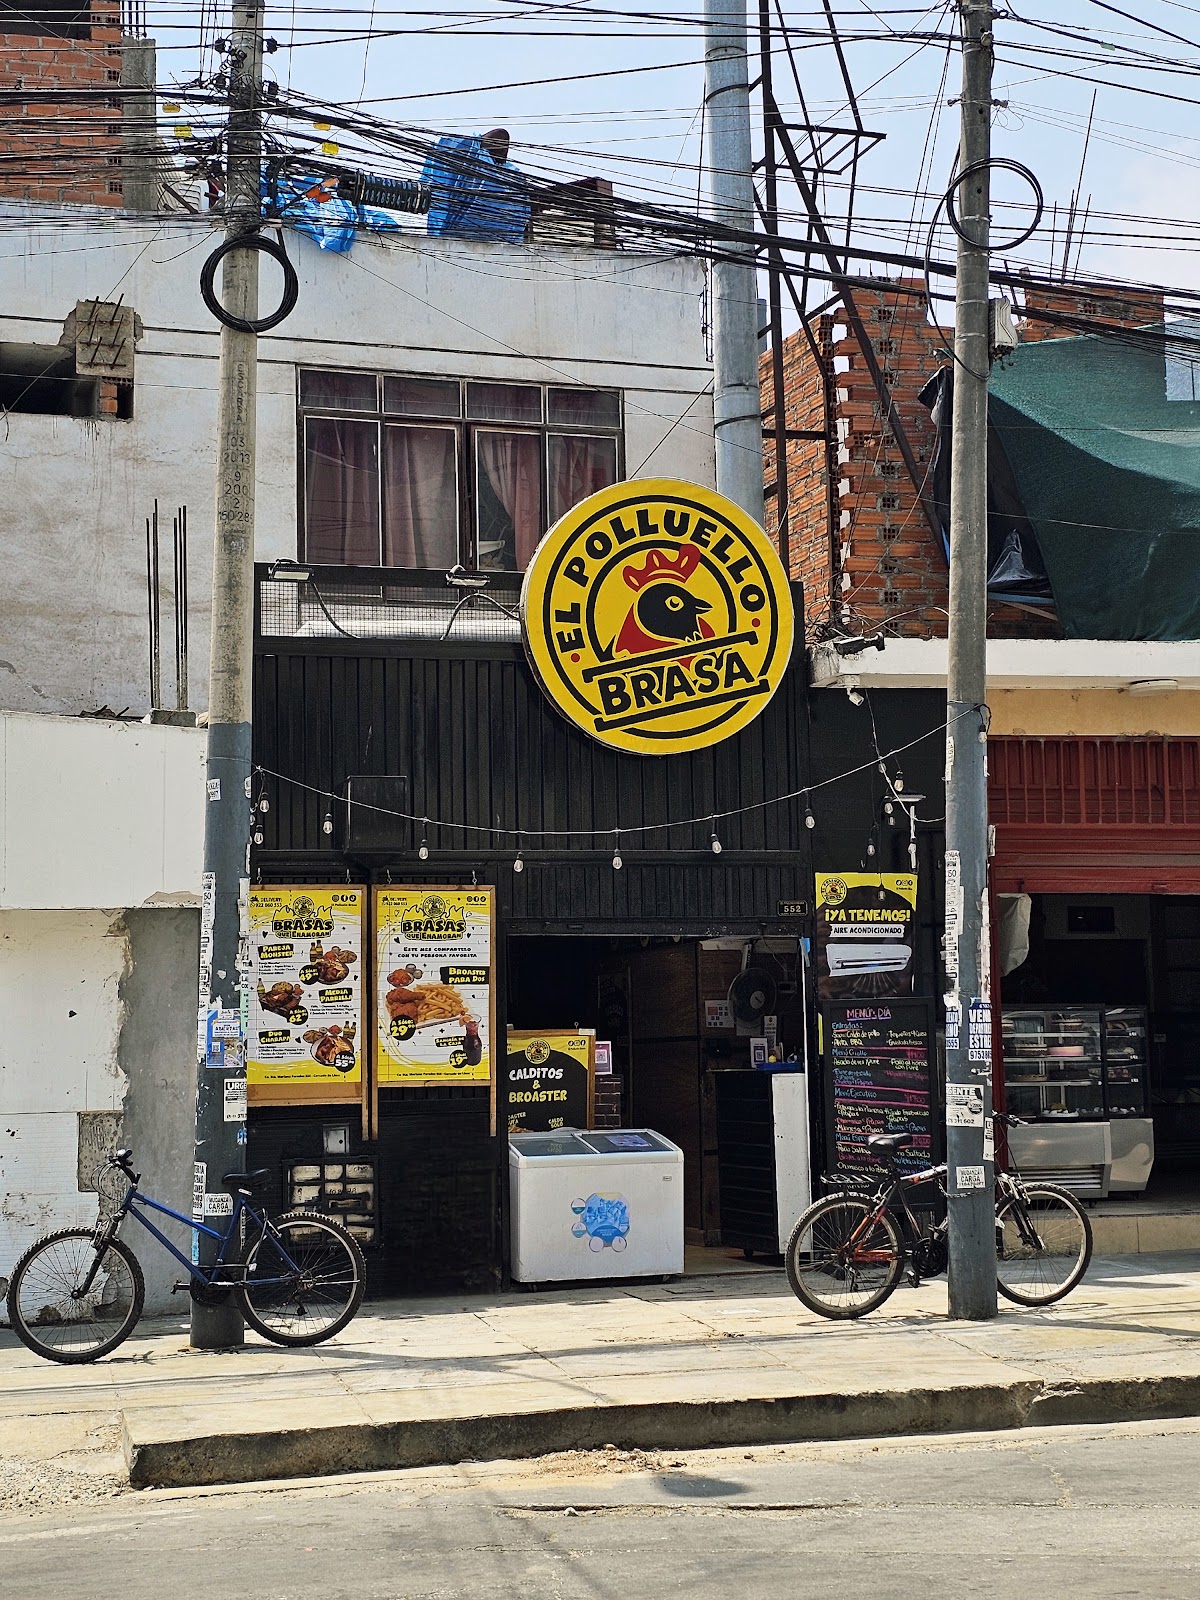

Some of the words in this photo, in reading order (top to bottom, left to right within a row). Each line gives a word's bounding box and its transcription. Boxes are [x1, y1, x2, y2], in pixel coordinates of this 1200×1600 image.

[562, 508, 766, 613] POLLUELLO
[554, 602, 586, 653] EL
[597, 651, 755, 716] BRASA
[783, 905, 802, 913] 552
[825, 908, 846, 922] ¡YA
[848, 909, 911, 922] TENEMOS!
[273, 919, 333, 930] BRASAS
[402, 919, 465, 932] BRASAS
[262, 944, 290, 952] PAREJA
[260, 950, 294, 959] MONSTER
[448, 967, 486, 976] BROASTER
[320, 994, 353, 1002] PARRILLA
[260, 1035, 291, 1043] CHARAPA
[532, 1080, 541, 1090] &
[508, 1090, 568, 1103] BROASTER
[960, 1175, 981, 1183] CARGA
[208, 1202, 229, 1210] CARGA
